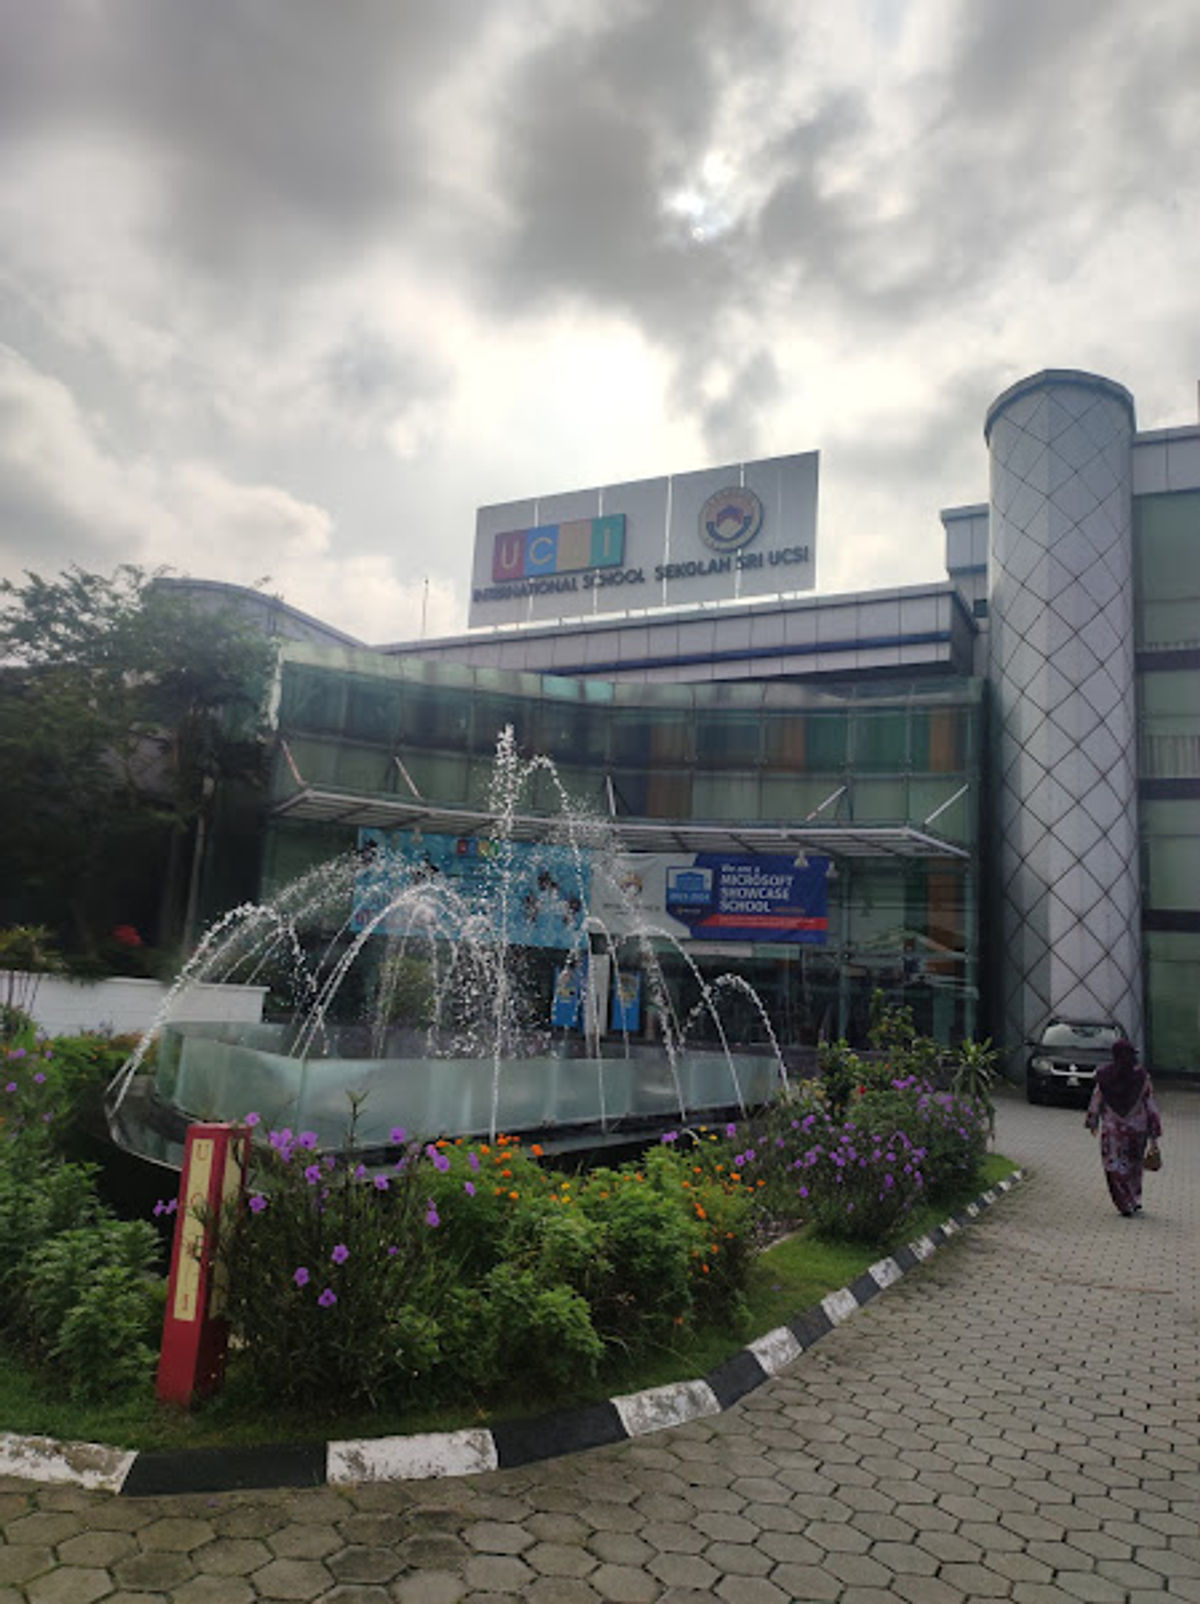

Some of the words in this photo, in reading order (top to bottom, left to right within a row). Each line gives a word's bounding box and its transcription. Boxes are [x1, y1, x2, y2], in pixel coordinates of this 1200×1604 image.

[655, 557, 731, 581] SEKOLAH
[736, 553, 763, 570] SRI
[769, 546, 809, 565] UCSI
[473, 577, 578, 602] INTERNATIONAL
[583, 567, 645, 589] SCHOOL
[721, 874, 794, 887] MICROSOFT
[720, 887, 789, 900] SHOWCASE
[720, 900, 772, 913] SCHOOL
